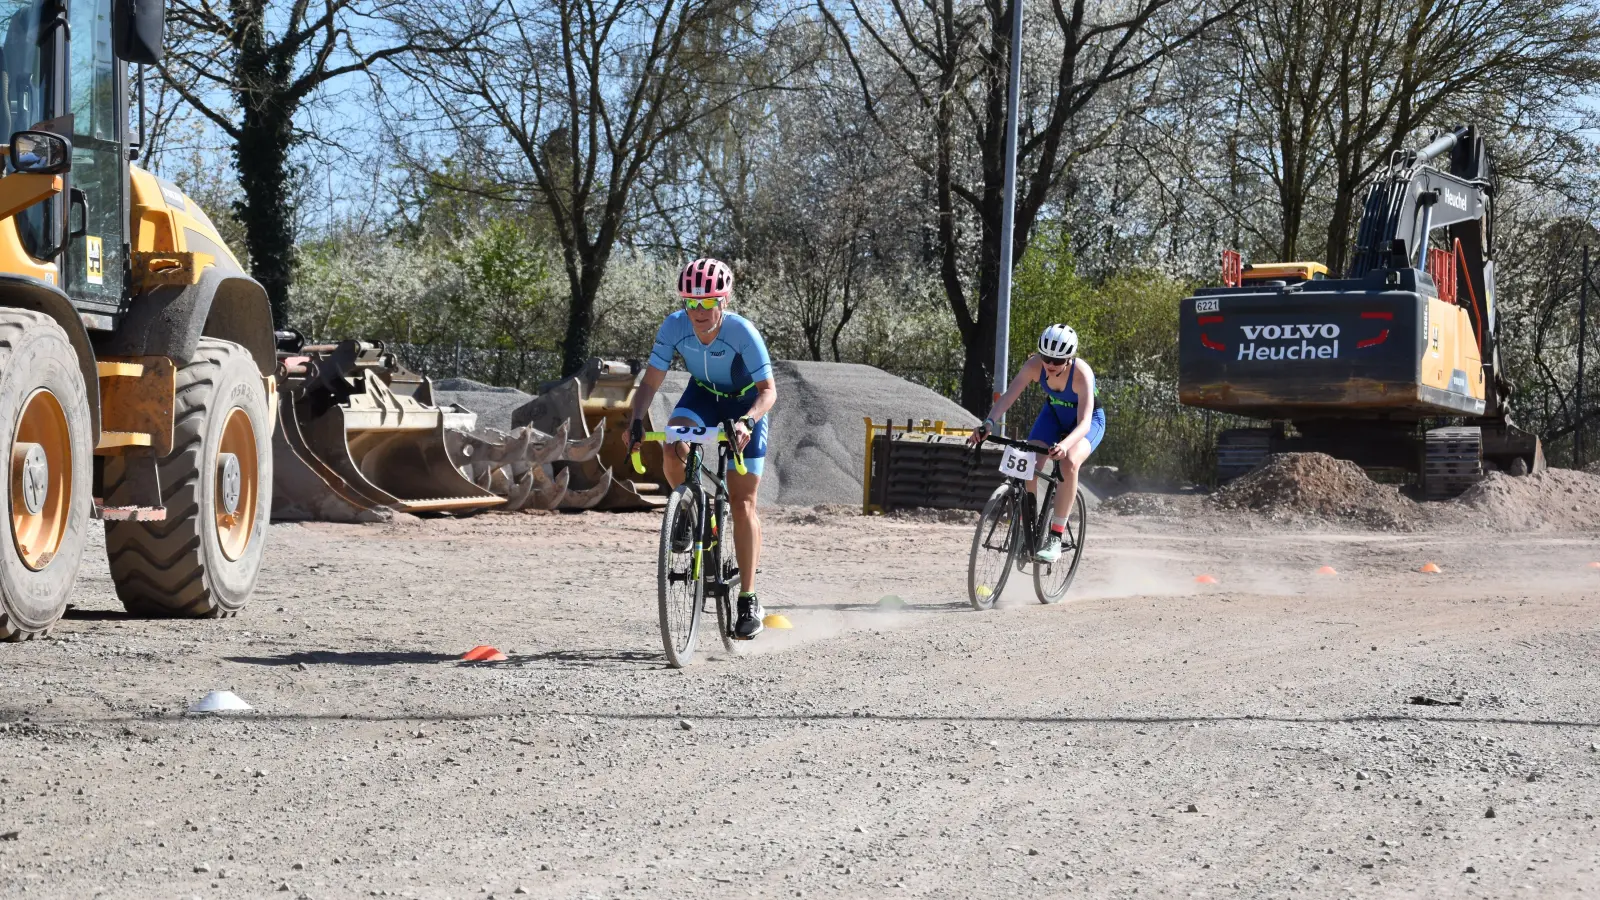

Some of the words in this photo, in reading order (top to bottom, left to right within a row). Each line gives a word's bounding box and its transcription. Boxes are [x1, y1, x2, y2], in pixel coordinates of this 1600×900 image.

[1444, 187, 1467, 212] Heuchel
[1197, 301, 1218, 311] 6221
[1240, 323, 1340, 340] VOLVO
[1237, 339, 1339, 361] Heuchel
[1006, 454, 1028, 473] 58
